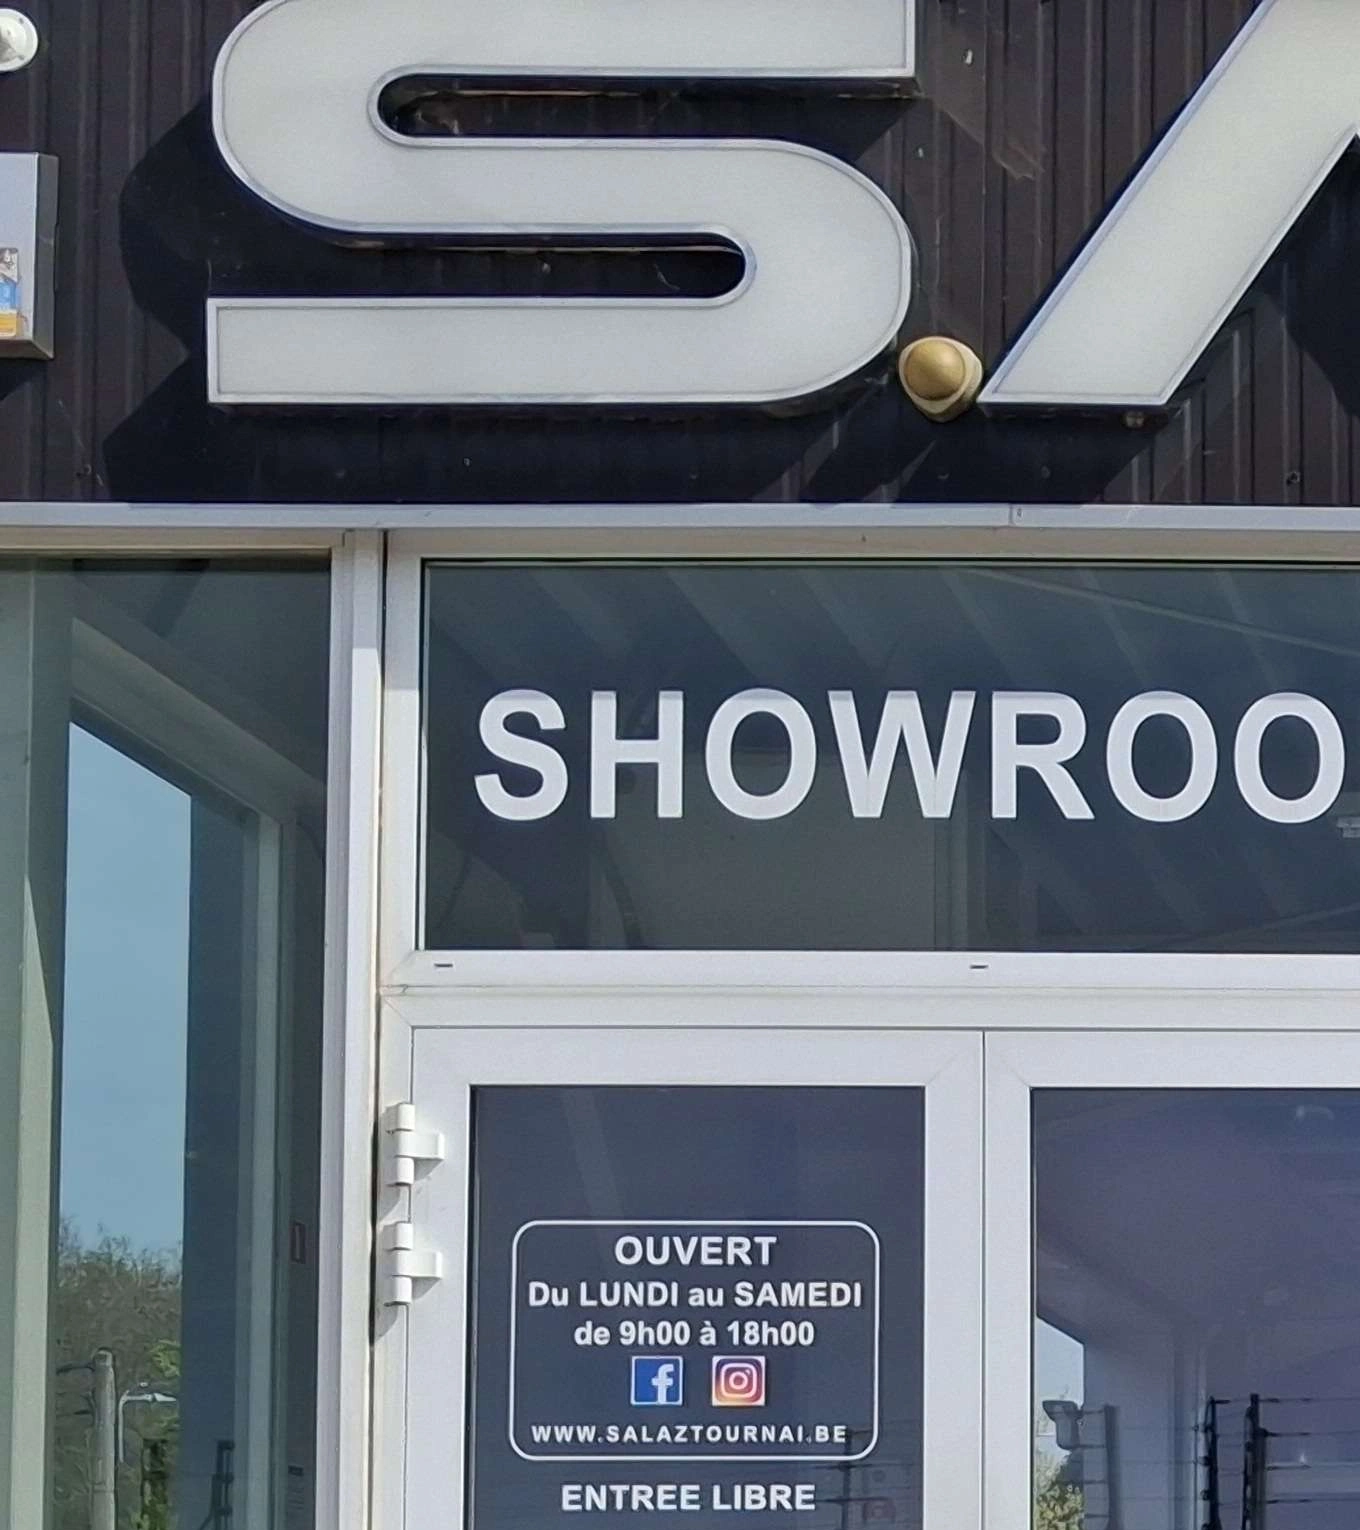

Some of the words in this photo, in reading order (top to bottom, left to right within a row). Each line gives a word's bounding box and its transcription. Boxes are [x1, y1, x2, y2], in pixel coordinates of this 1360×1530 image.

[613, 1235, 778, 1267] OUVERT
[527, 1281, 569, 1308] Du
[579, 1281, 679, 1308] LUNDI
[687, 1285, 725, 1308] au
[733, 1280, 863, 1308] SAMEDI
[573, 1320, 611, 1346] de
[618, 1320, 692, 1347] 9h00
[698, 1318, 718, 1347] à
[726, 1320, 816, 1347] 18h00
[531, 1424, 848, 1445] WWW.SALAZTOURNAI.BE
[560, 1484, 702, 1512] ENTREE
[712, 1484, 817, 1512] LIBRE
